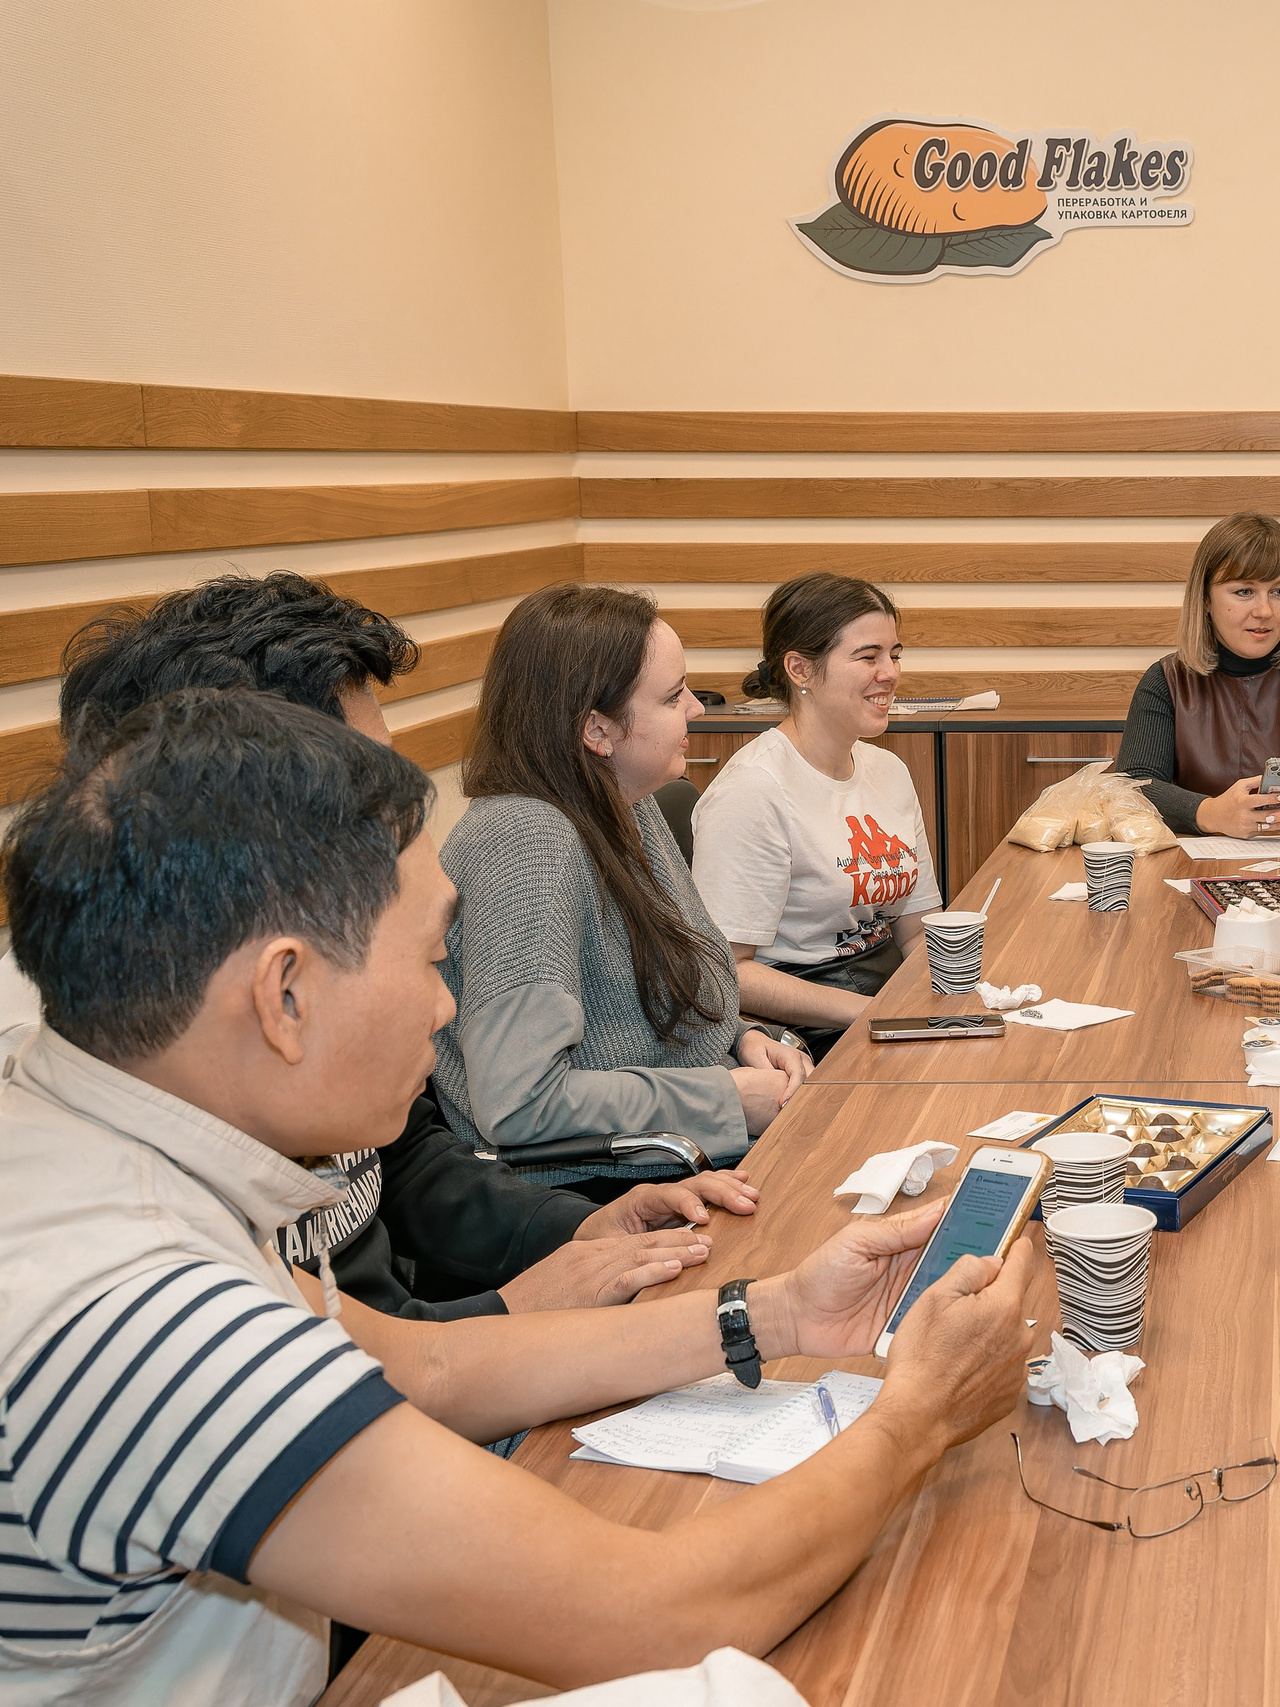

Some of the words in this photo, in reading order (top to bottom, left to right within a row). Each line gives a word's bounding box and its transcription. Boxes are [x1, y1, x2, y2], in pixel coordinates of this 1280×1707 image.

[913, 137, 1030, 188] Good
[1036, 137, 1185, 188] Flakes
[1057, 197, 1137, 207] ПЕРЕРАБОТКА
[1139, 197, 1148, 206] И
[1057, 210, 1118, 220] УПАКОВКА
[1121, 209, 1188, 219] КАРТОФЕЛЯ
[849, 868, 918, 907] Kappa
